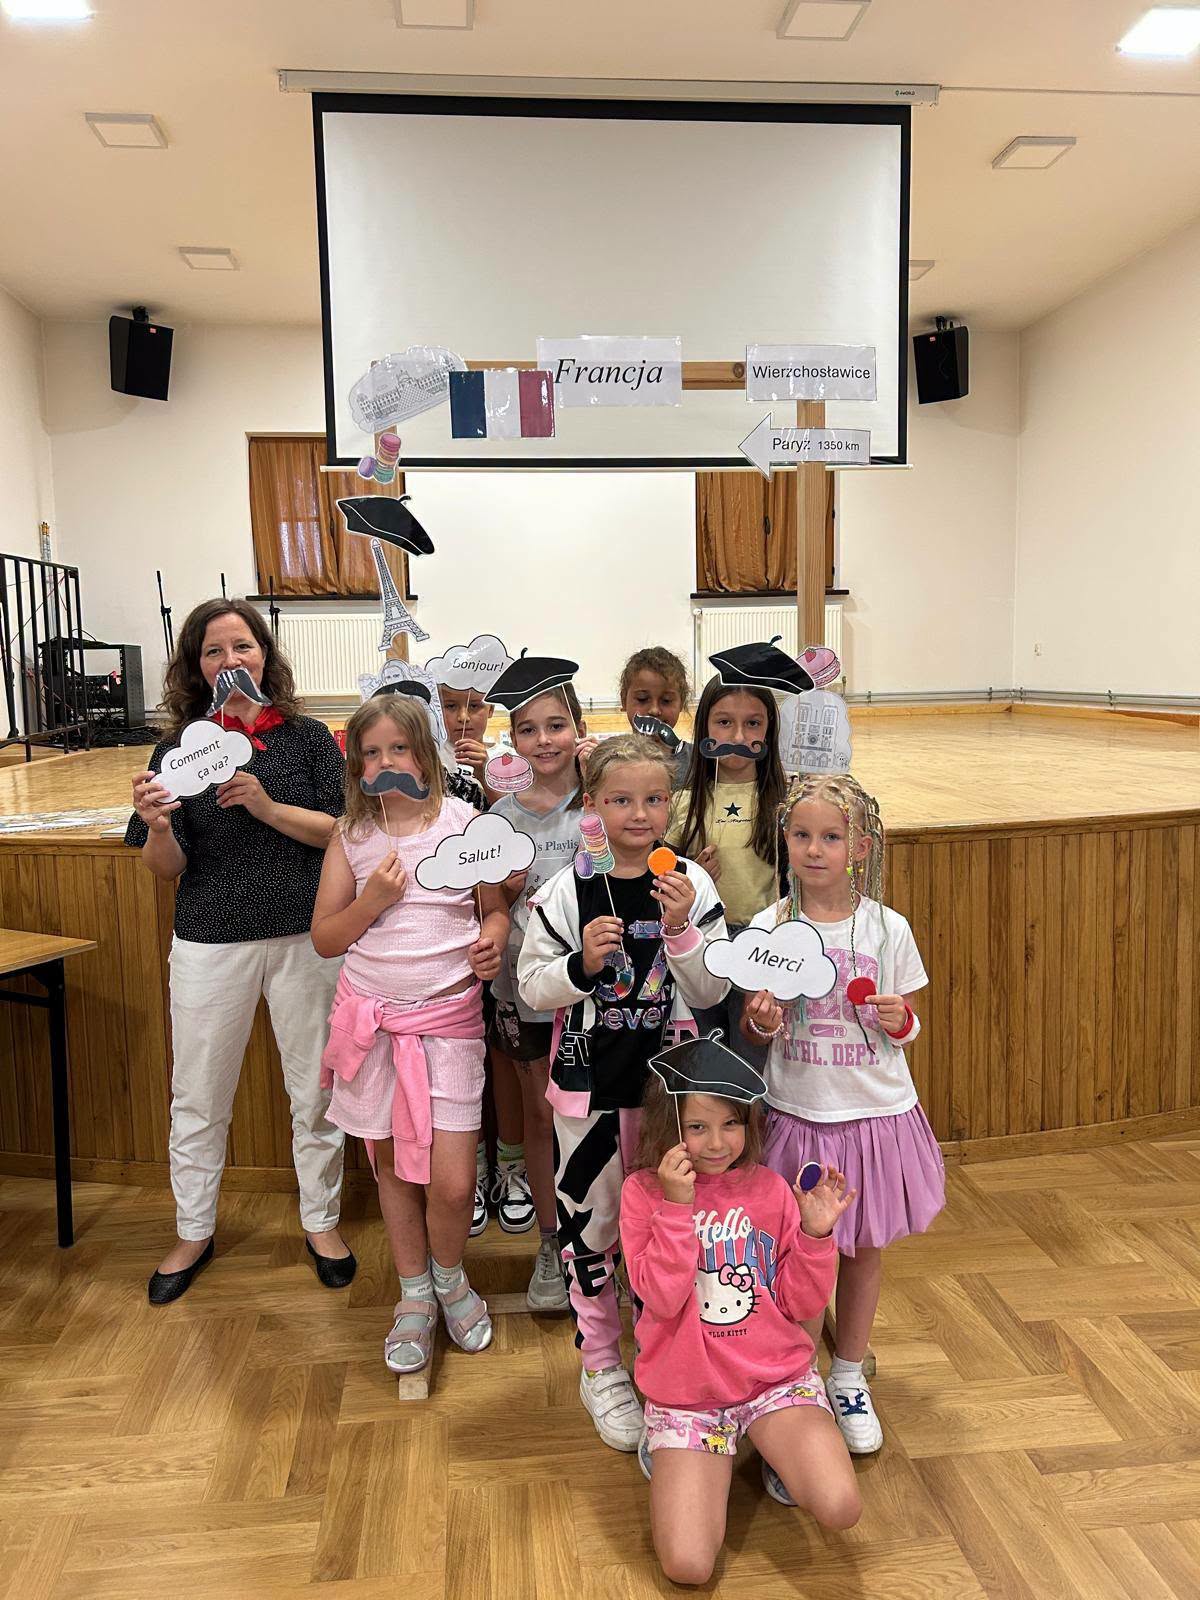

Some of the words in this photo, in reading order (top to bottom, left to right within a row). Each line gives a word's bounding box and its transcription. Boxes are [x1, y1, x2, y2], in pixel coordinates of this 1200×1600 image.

[554, 358, 663, 391] Francja
[752, 365, 871, 379] Wierzchosławice
[817, 440, 843, 451] 1350
[845, 441, 860, 451] km
[169, 740, 221, 770] Comment
[197, 767, 210, 780] ça
[211, 755, 229, 771] va?
[458, 844, 501, 866] Salut!
[545, 839, 579, 852] Playlis
[747, 946, 805, 973] Merci
[831, 1042, 880, 1067] DEPT.
[692, 1206, 753, 1250] Hello
